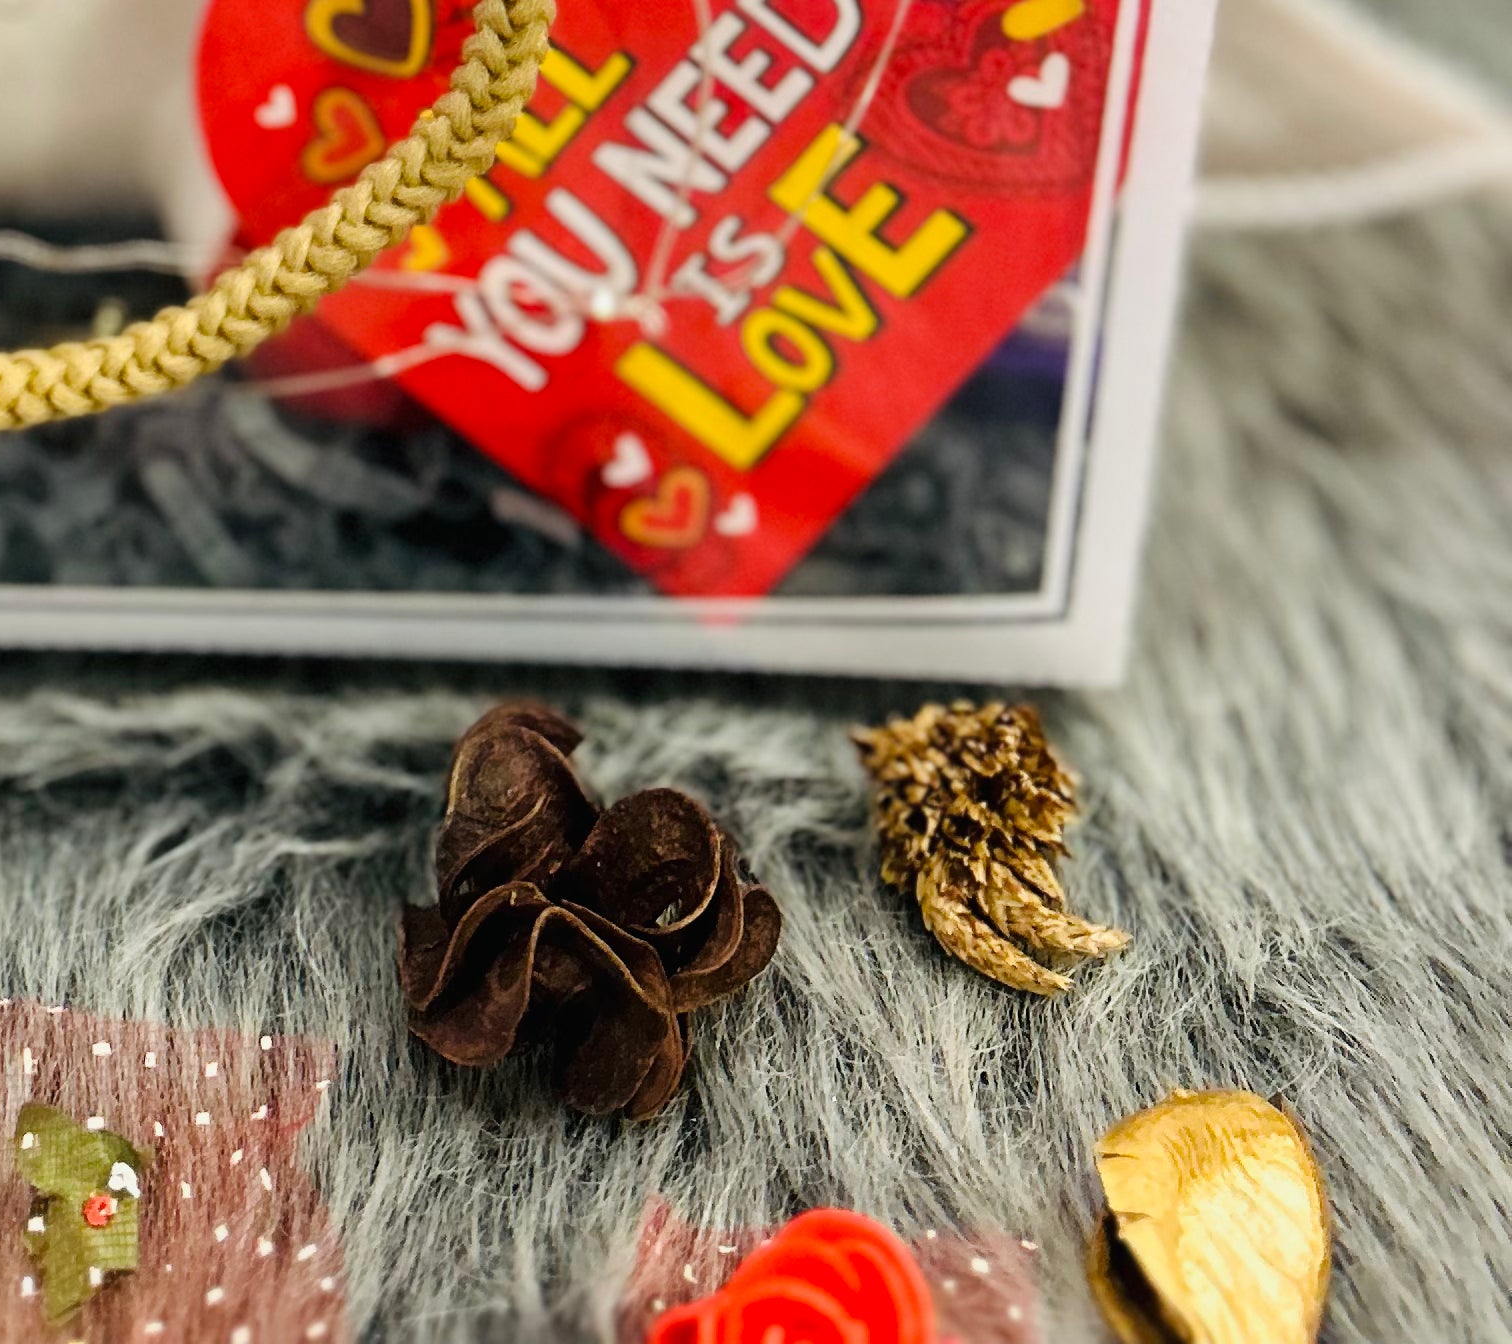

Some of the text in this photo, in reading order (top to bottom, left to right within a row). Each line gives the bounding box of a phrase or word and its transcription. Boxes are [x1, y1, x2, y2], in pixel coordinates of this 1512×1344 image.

[464, 41, 637, 224] LL
[425, 187, 638, 391] YOU
[614, 123, 974, 471] LOVE
[670, 215, 787, 325] IS
